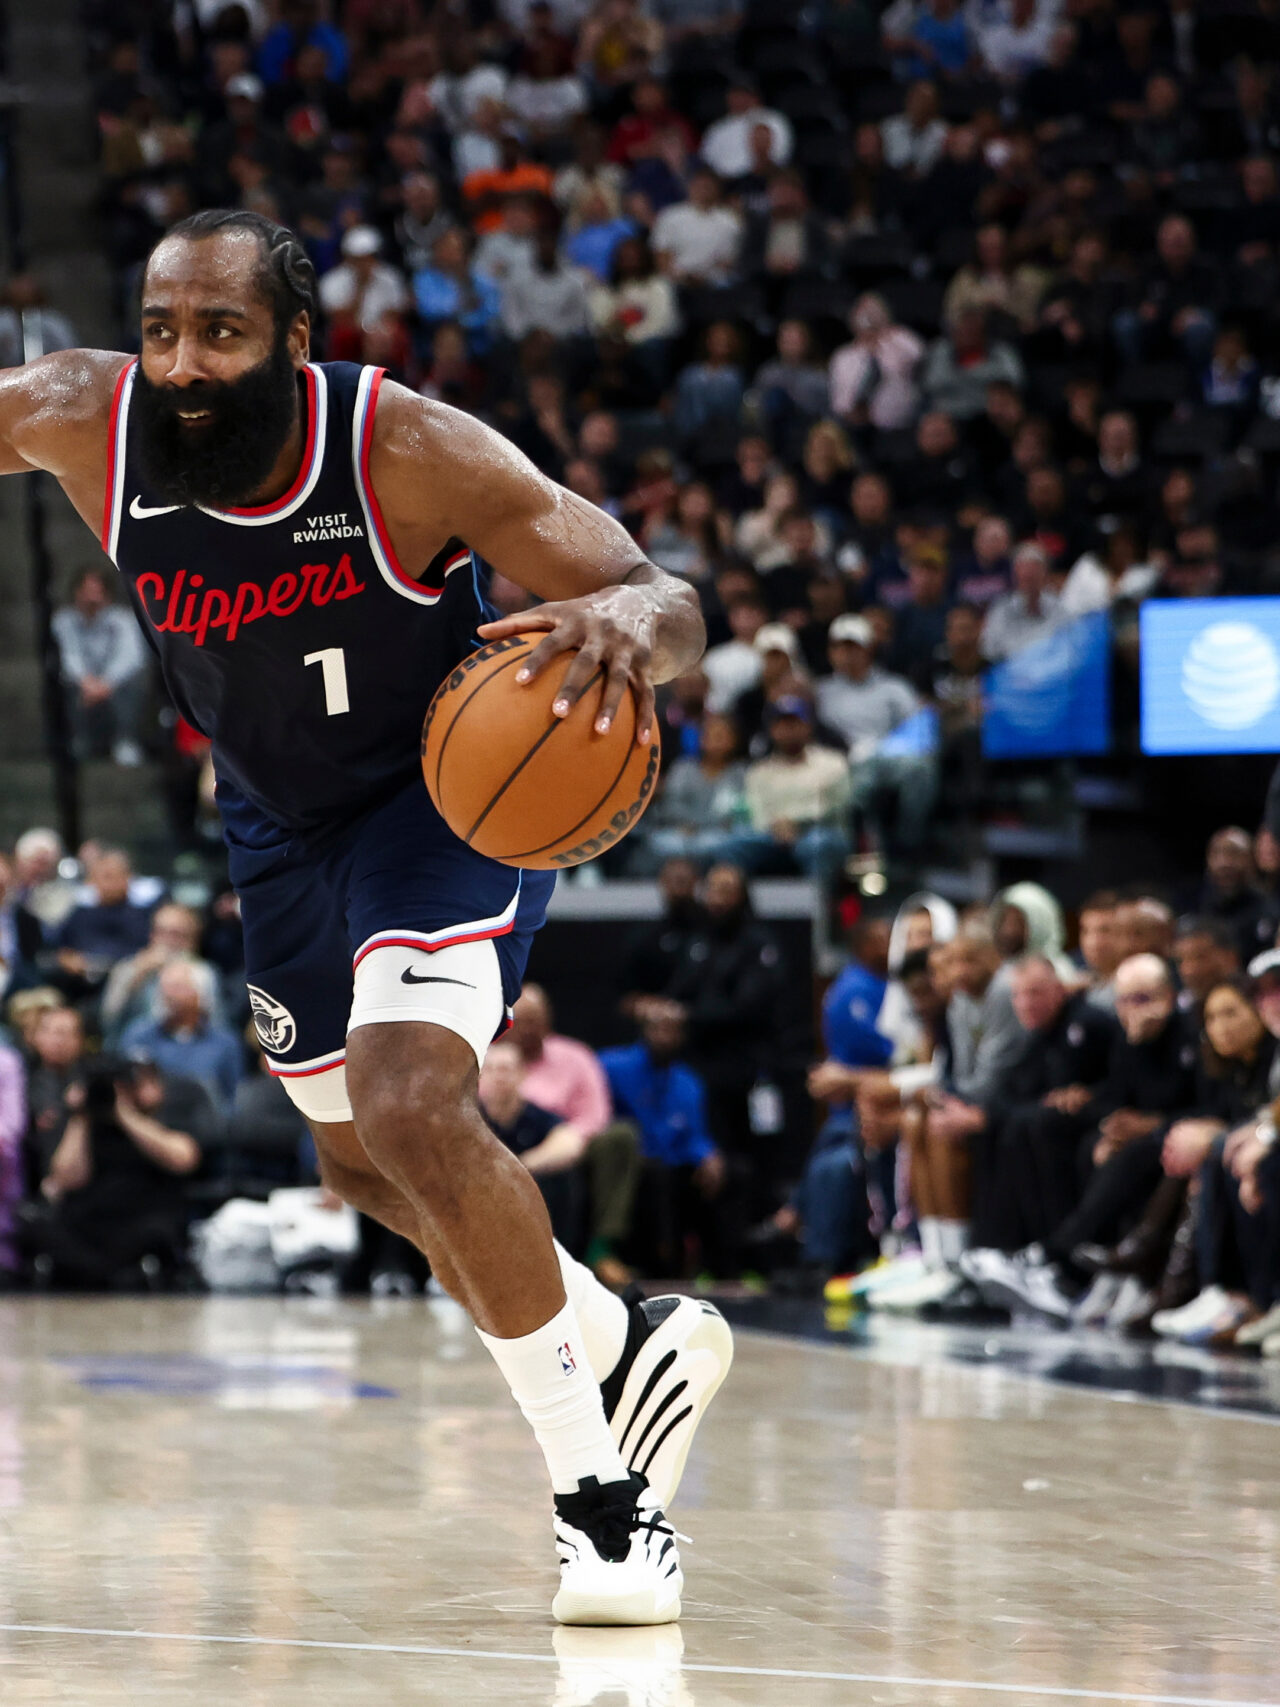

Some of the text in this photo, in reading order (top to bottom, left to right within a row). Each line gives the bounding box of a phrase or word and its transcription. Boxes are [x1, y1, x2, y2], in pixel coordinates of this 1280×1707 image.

[293, 525, 364, 544] RWANDA
[306, 513, 348, 529] VISIT
[135, 553, 367, 646] Clippers
[303, 648, 350, 716] 1
[549, 743, 659, 864] Wilson
